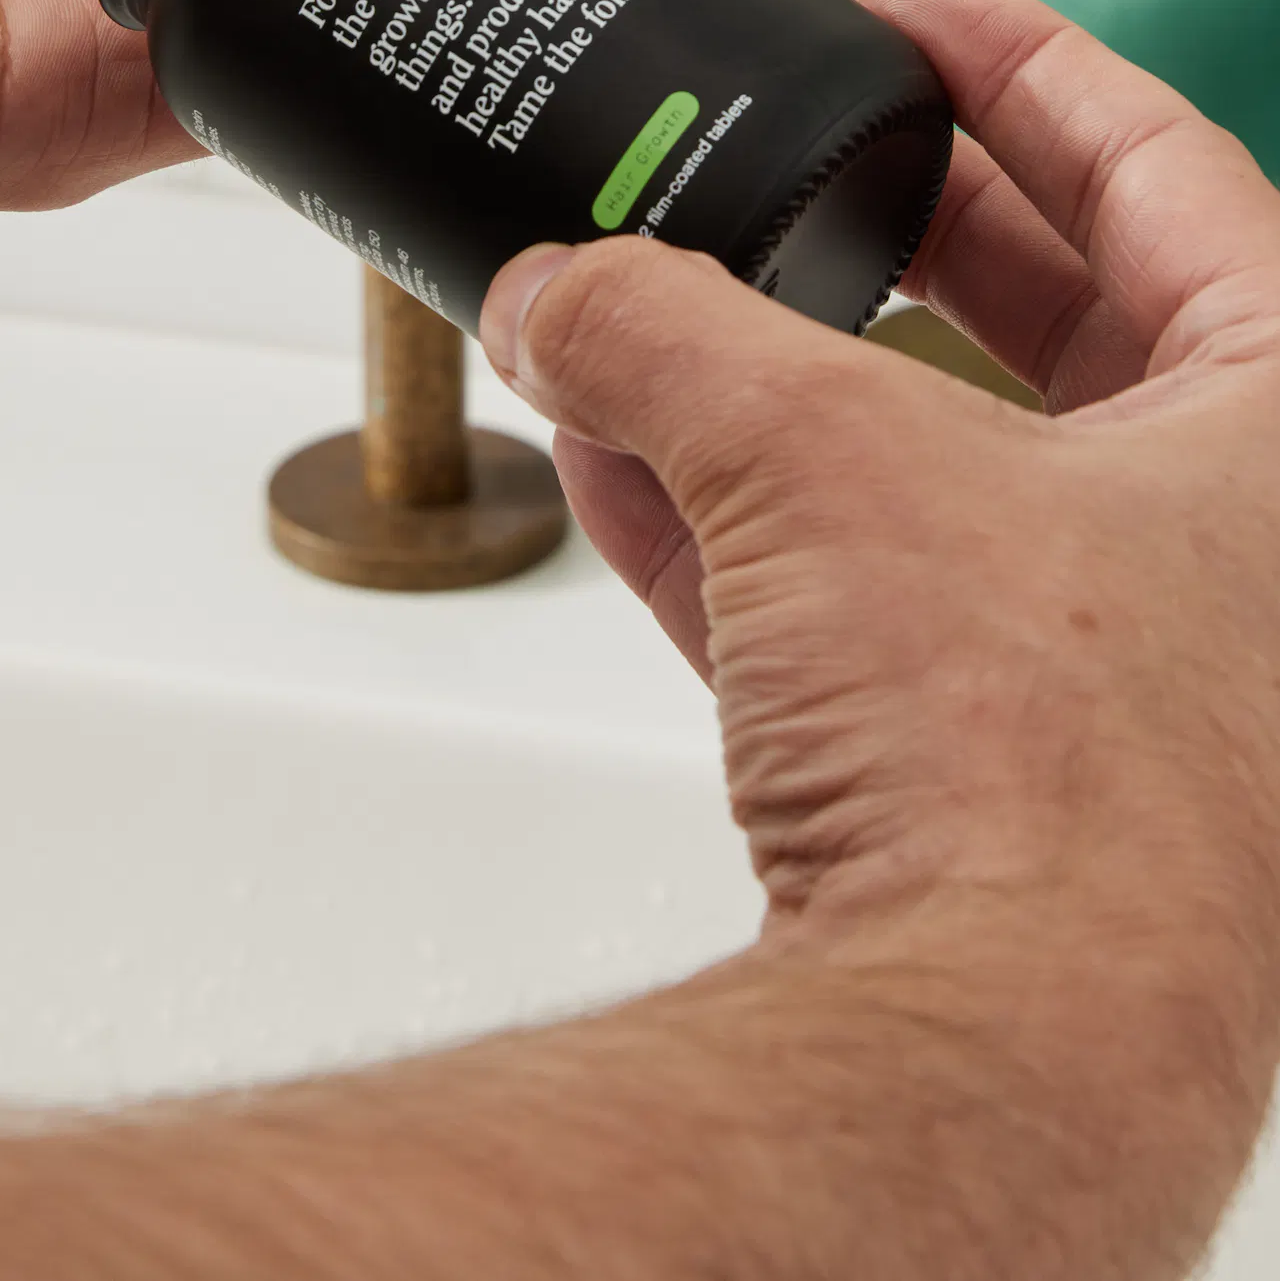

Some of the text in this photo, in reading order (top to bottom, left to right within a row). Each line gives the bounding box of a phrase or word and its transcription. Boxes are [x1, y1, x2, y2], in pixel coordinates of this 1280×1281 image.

[395, 0, 474, 92] things.
[430, 50, 476, 115] and
[454, 27, 543, 137] healthy
[487, 75, 556, 154] Tame
[542, 26, 593, 74] the
[605, 107, 685, 212] Hair Growth
[646, 137, 713, 226] film-coated
[705, 93, 753, 142] tablets
